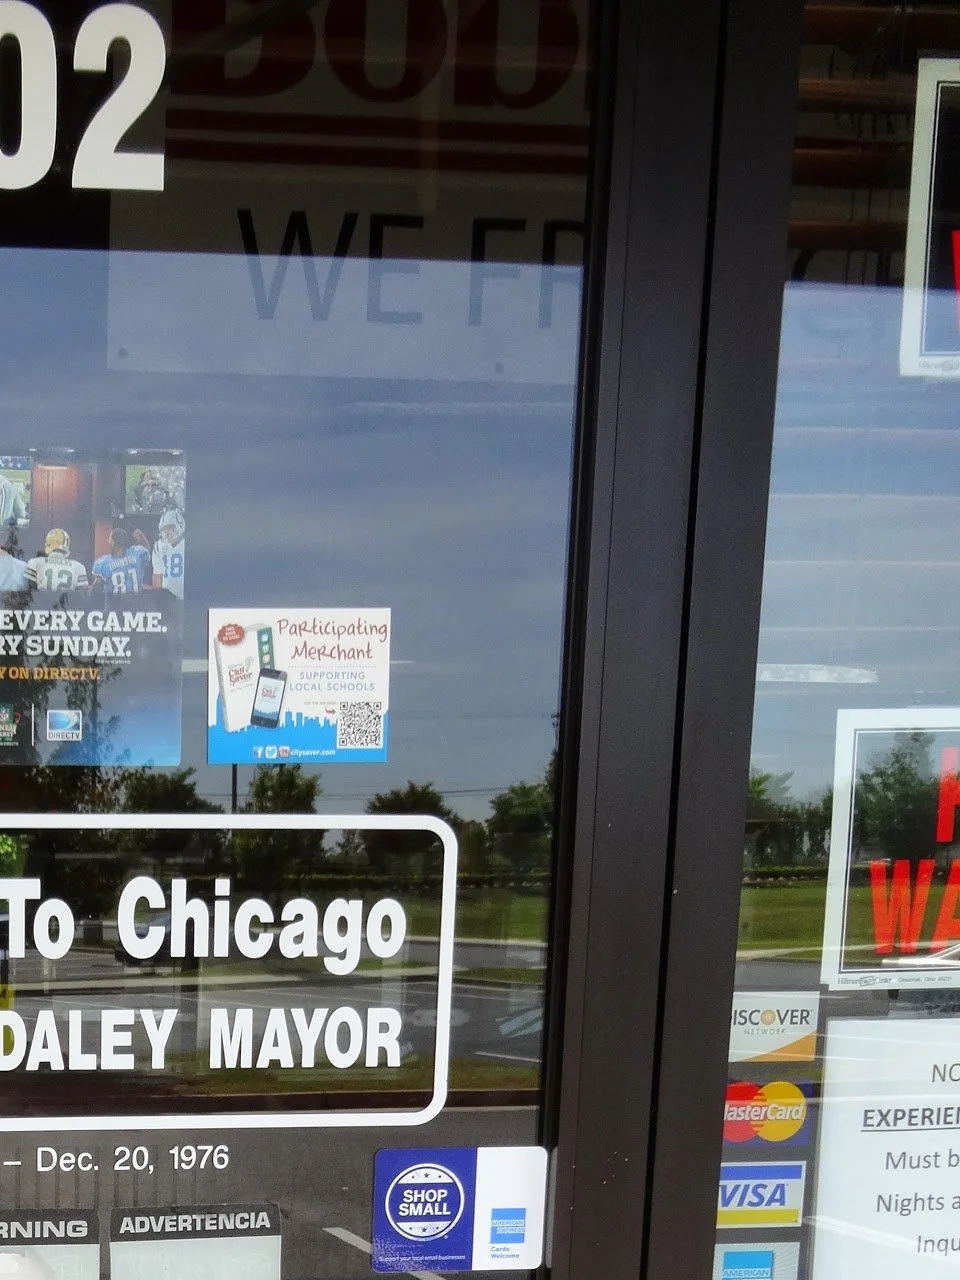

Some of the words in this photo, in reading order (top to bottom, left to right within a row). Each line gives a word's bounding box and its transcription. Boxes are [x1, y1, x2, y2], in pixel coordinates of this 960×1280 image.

[237, 207, 422, 325] WE
[44, 568, 74, 591] 12
[110, 568, 141, 594] 81
[86, 611, 168, 633] GAME.
[26, 635, 132, 657] SUNDAY.
[9, 667, 30, 680] ON
[33, 667, 100, 681] DIRECTV.
[299, 671, 366, 680] SUPPORTING
[289, 682, 323, 691] LOCAL
[327, 682, 375, 691] SCHOOLS
[48, 732, 81, 740] DIRECTV
[290, 749, 336, 757] citysaver.com
[117, 876, 407, 976] Chicago
[732, 1008, 811, 1026] ISCOVER
[209, 1006, 403, 1070] MAYOR
[36, 1146, 100, 1173] Dec.
[113, 1145, 155, 1175] 20,
[169, 1144, 230, 1170] 1976
[885, 1151, 941, 1170] Must
[402, 1189, 448, 1203] SHOP
[719, 1183, 786, 1208] VISA
[876, 1192, 945, 1216] Nights
[398, 1202, 452, 1216] SMALL
[119, 1211, 271, 1234] ADVERTENCIA
[723, 1268, 770, 1277] AMERICAN
